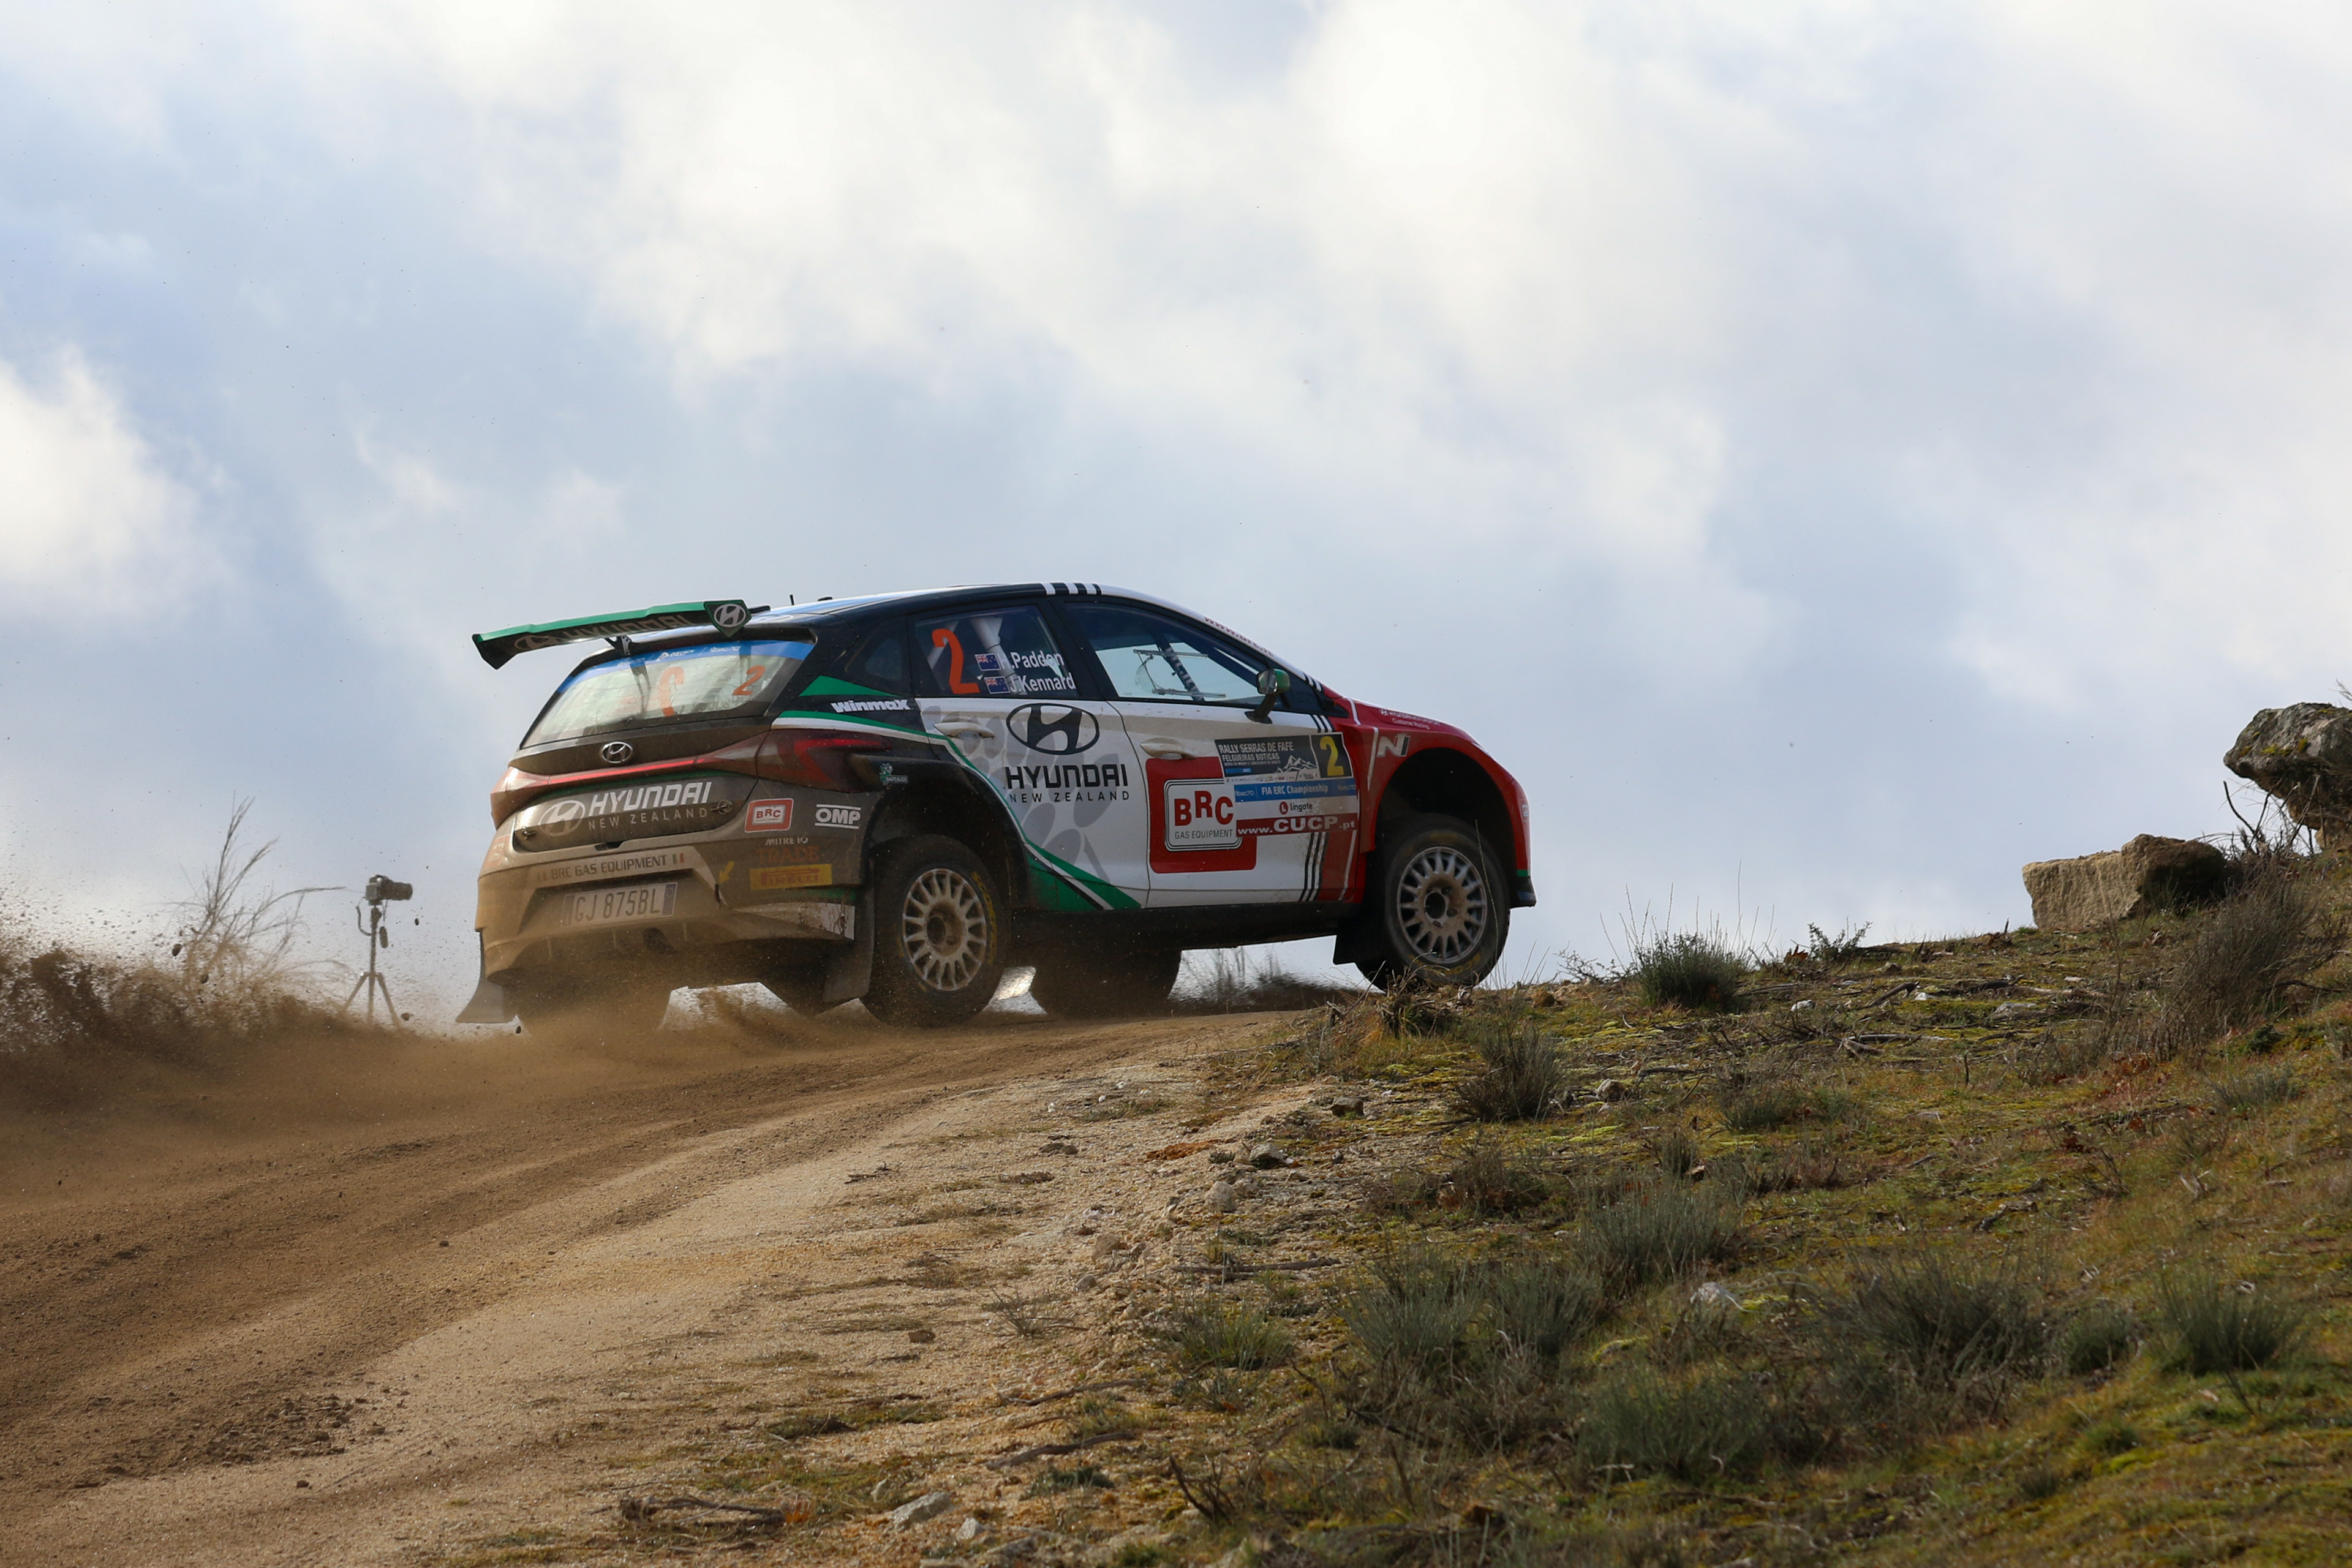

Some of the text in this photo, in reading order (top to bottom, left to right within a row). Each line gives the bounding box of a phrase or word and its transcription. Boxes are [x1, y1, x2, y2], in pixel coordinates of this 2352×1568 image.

[932, 628, 980, 694] 2
[997, 650, 1065, 669] H.Paddon
[732, 665, 766, 696] 2
[1009, 672, 1077, 693] J.Kennard
[1218, 741, 1294, 753] RALLY SERRAS DE FAFE
[1319, 736, 1344, 777] 2
[1221, 752, 1280, 762] FELGUEIRAS BOTICAS
[1005, 764, 1128, 790] HYUNDAI
[588, 782, 712, 815] HYUNDAI
[1009, 790, 1130, 803] NEW ZEALAND
[1261, 783, 1329, 796] FIA ERC Championship
[756, 809, 782, 818] BRC
[815, 807, 861, 825] OMP
[1174, 790, 1234, 826] BRC
[1290, 802, 1313, 812] lingote
[588, 807, 708, 831] NEW ZEALAND
[1237, 815, 1355, 835] www.CUCP.pt
[765, 837, 794, 846] MITRE
[1175, 829, 1233, 840] GAS EQUIPMENT
[755, 845, 820, 864] TRADE
[551, 854, 667, 880] BRC GAS EQUIPMENT
[760, 868, 820, 886] PIRELLI
[603, 888, 661, 919] 875BL
